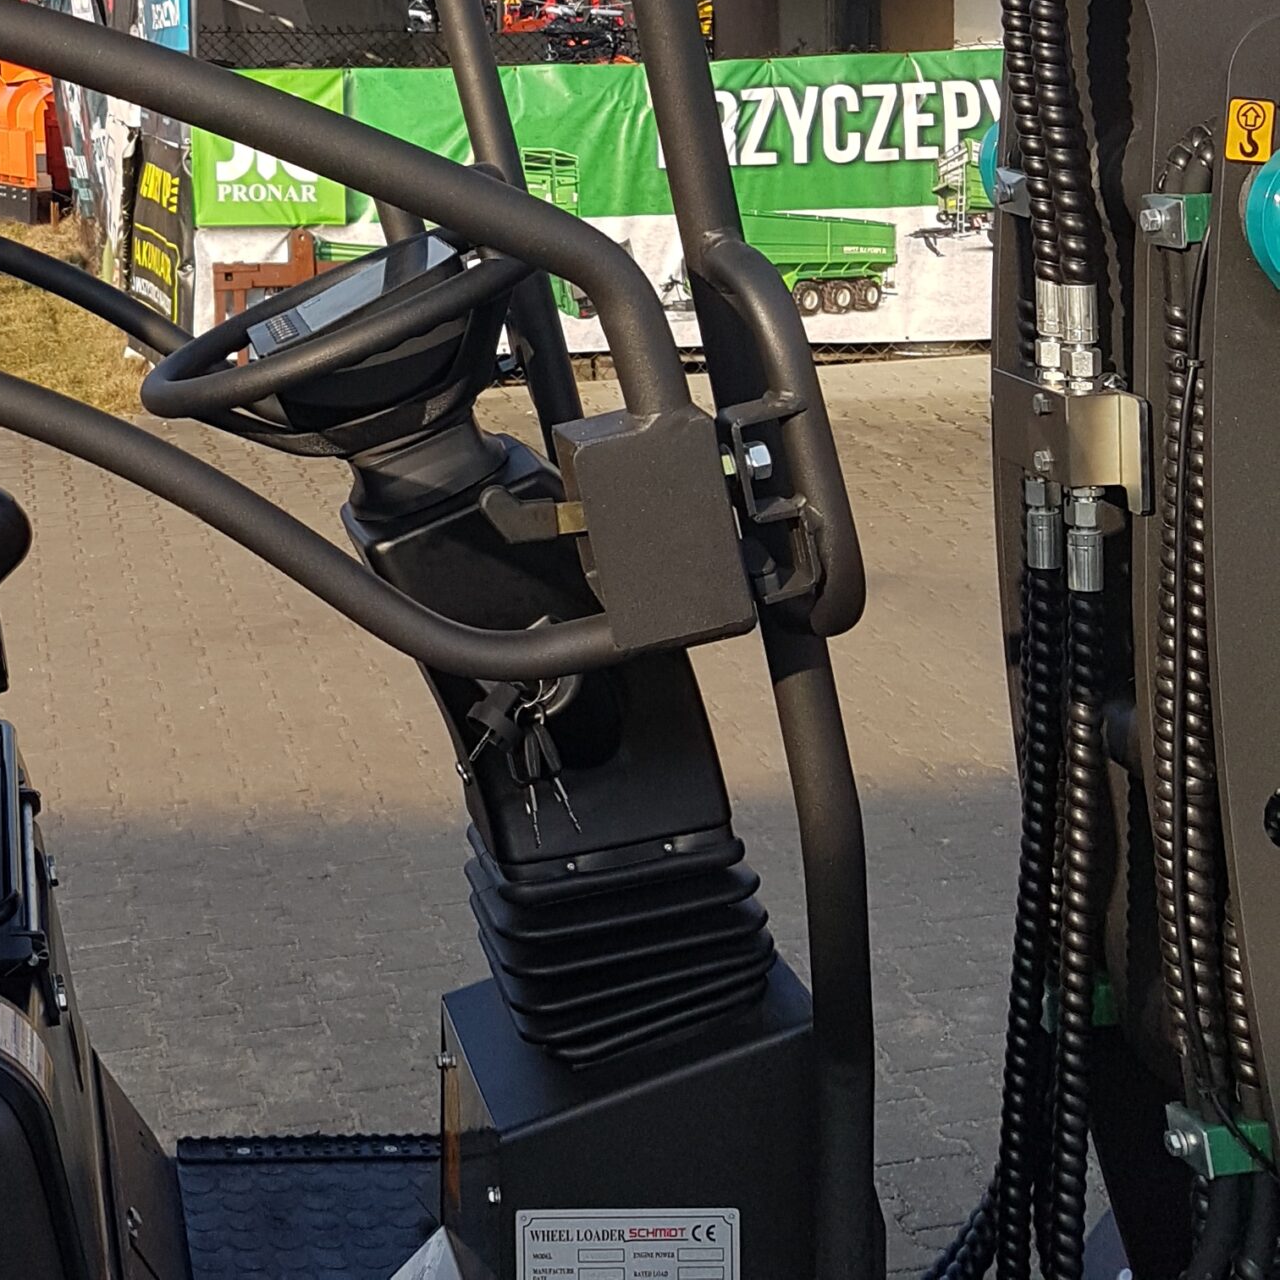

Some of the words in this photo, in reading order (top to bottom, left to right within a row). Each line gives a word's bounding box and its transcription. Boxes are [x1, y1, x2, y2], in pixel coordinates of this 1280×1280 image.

[658, 78, 1001, 169] RZYCZEP
[216, 182, 318, 204] PRONAR
[530, 1228, 574, 1242] WHEEL
[576, 1228, 626, 1242] LOADER
[628, 1227, 687, 1239] SCHMIDT
